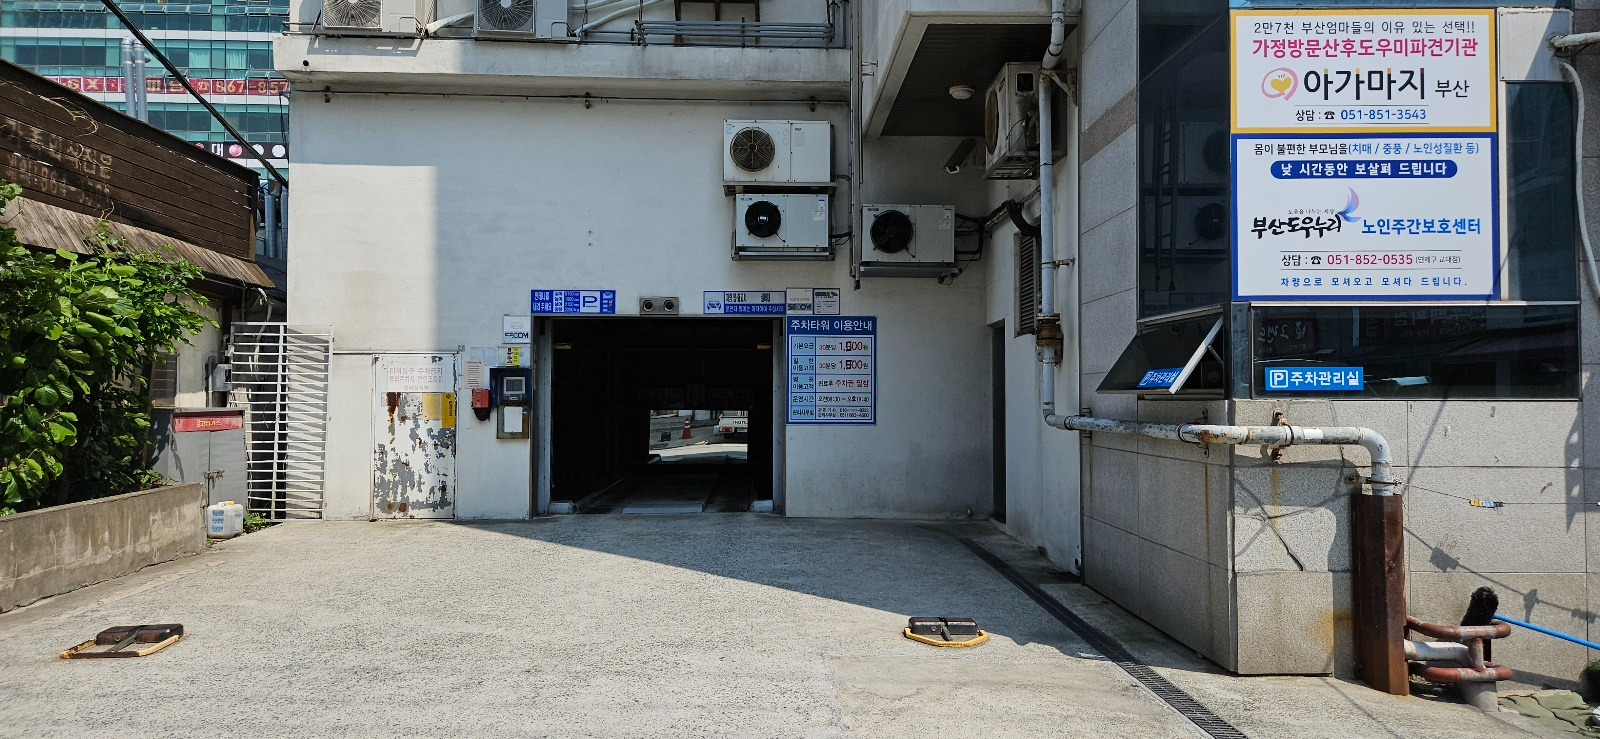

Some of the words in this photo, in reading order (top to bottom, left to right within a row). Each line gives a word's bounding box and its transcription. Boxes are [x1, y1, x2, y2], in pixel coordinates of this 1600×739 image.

[1254, 21, 1295, 34] 2만7천
[1301, 20, 1374, 34] 부산엄마들의
[1382, 20, 1406, 33] 이유
[1412, 20, 1435, 33] 있는
[1442, 20, 1475, 33] 선택!!
[1252, 37, 1478, 59] 가정방문산후도우미파견기관
[1303, 67, 1425, 101] 아가마지
[1434, 79, 1470, 98] 부산
[1295, 109, 1315, 122] 상담
[1340, 109, 1427, 121] 051-851-3543
[1254, 144, 1274, 156] 몸이
[1277, 143, 1306, 155] 불편한
[1382, 143, 1403, 155] 중풍
[1413, 142, 1463, 155] 노인성질환
[1465, 142, 1479, 155] 등)
[1281, 164, 1293, 176] 낮
[1299, 163, 1348, 176] 시간동안
[1355, 163, 1392, 176] 보살펴
[1398, 162, 1447, 176] 드립니다
[1251, 214, 1342, 240] 부산도우누리
[1361, 217, 1481, 236] 노인주간보호센터
[1281, 254, 1302, 267] 상담
[1327, 253, 1413, 265] 051-852-0535
[1280, 276, 1323, 287] 차량으로
[1331, 276, 1373, 287] 모셔오고
[1381, 276, 1412, 287] 모셔다
[1420, 276, 1468, 287] 드립니다.
[791, 319, 830, 331] 주차타워
[833, 319, 872, 331] 이용안내
[1289, 370, 1360, 387] 주차관리실
